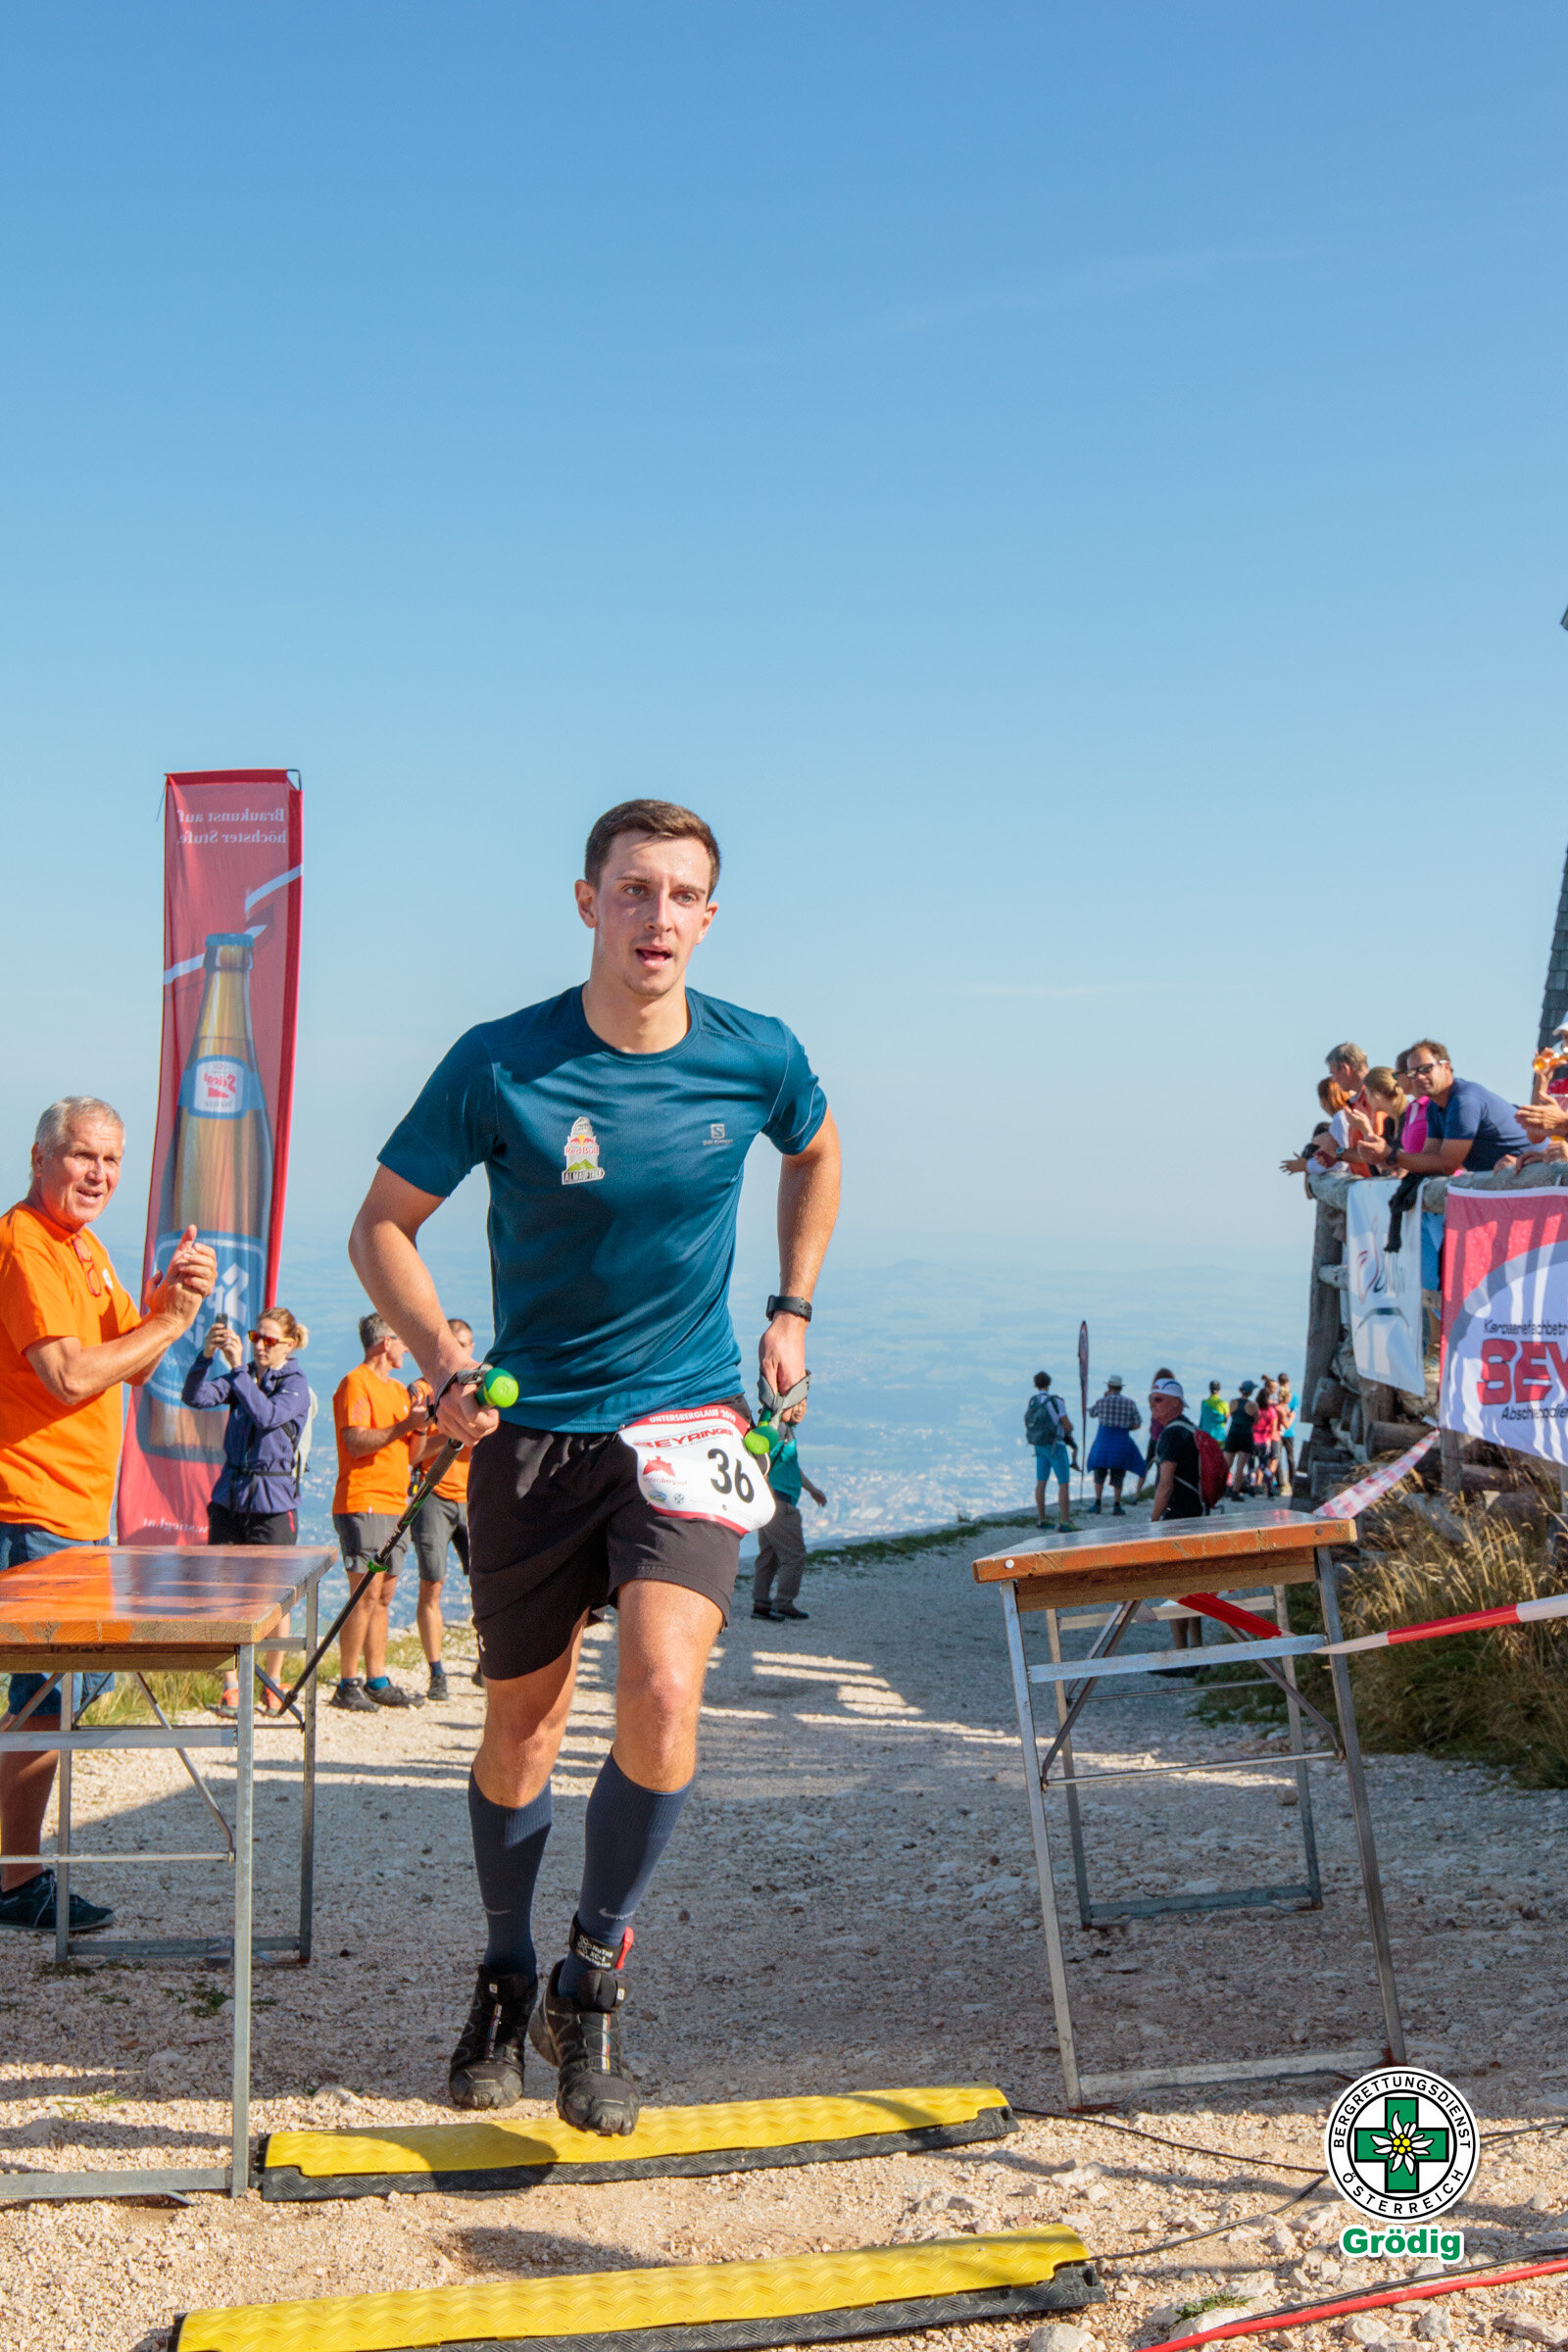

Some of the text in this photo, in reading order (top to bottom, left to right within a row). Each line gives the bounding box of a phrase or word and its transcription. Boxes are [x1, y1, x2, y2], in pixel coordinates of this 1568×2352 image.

[582, 1146, 600, 1154] Bull
[648, 1409, 719, 1423] UNTERSBERGLAUF
[707, 1447, 755, 1504] 36
